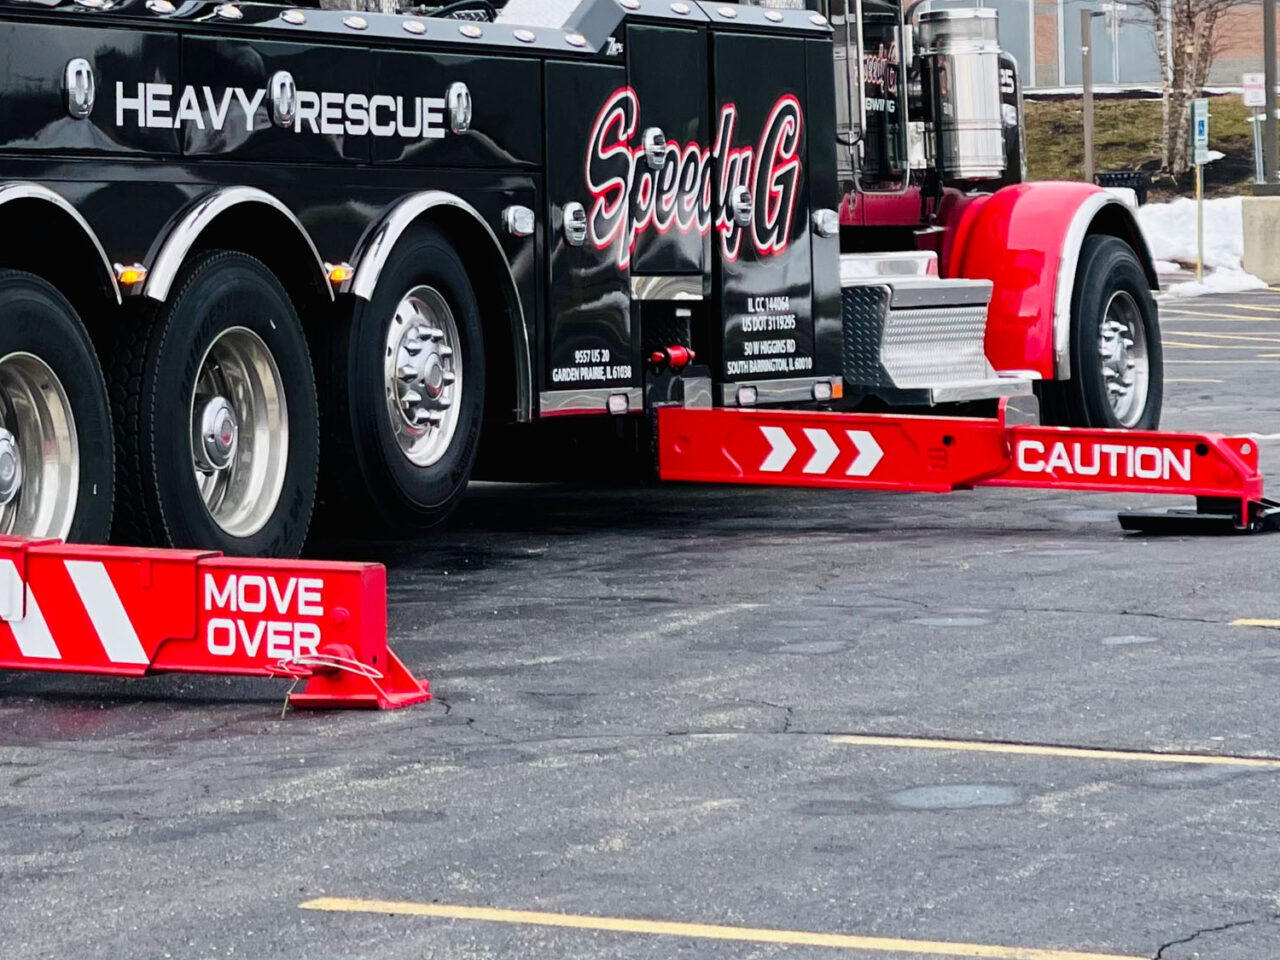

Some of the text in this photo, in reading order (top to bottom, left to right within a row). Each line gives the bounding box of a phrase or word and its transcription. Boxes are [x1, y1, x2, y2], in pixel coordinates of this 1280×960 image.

[115, 81, 446, 139] HEAVY RESCUE
[586, 86, 804, 270] Speedy G
[747, 297, 755, 312] IL
[755, 297, 765, 312] CC
[742, 316, 752, 332] US
[752, 316, 767, 331] DOT
[575, 349, 610, 363] 9557 US 20
[744, 339, 796, 356] 50 W HIGGINS RD
[552, 367, 580, 382] GARDEN
[727, 361, 749, 375] SOUTH
[1017, 440, 1191, 481] CAUTION
[204, 572, 324, 616] MOVE
[207, 617, 321, 664] OVER
